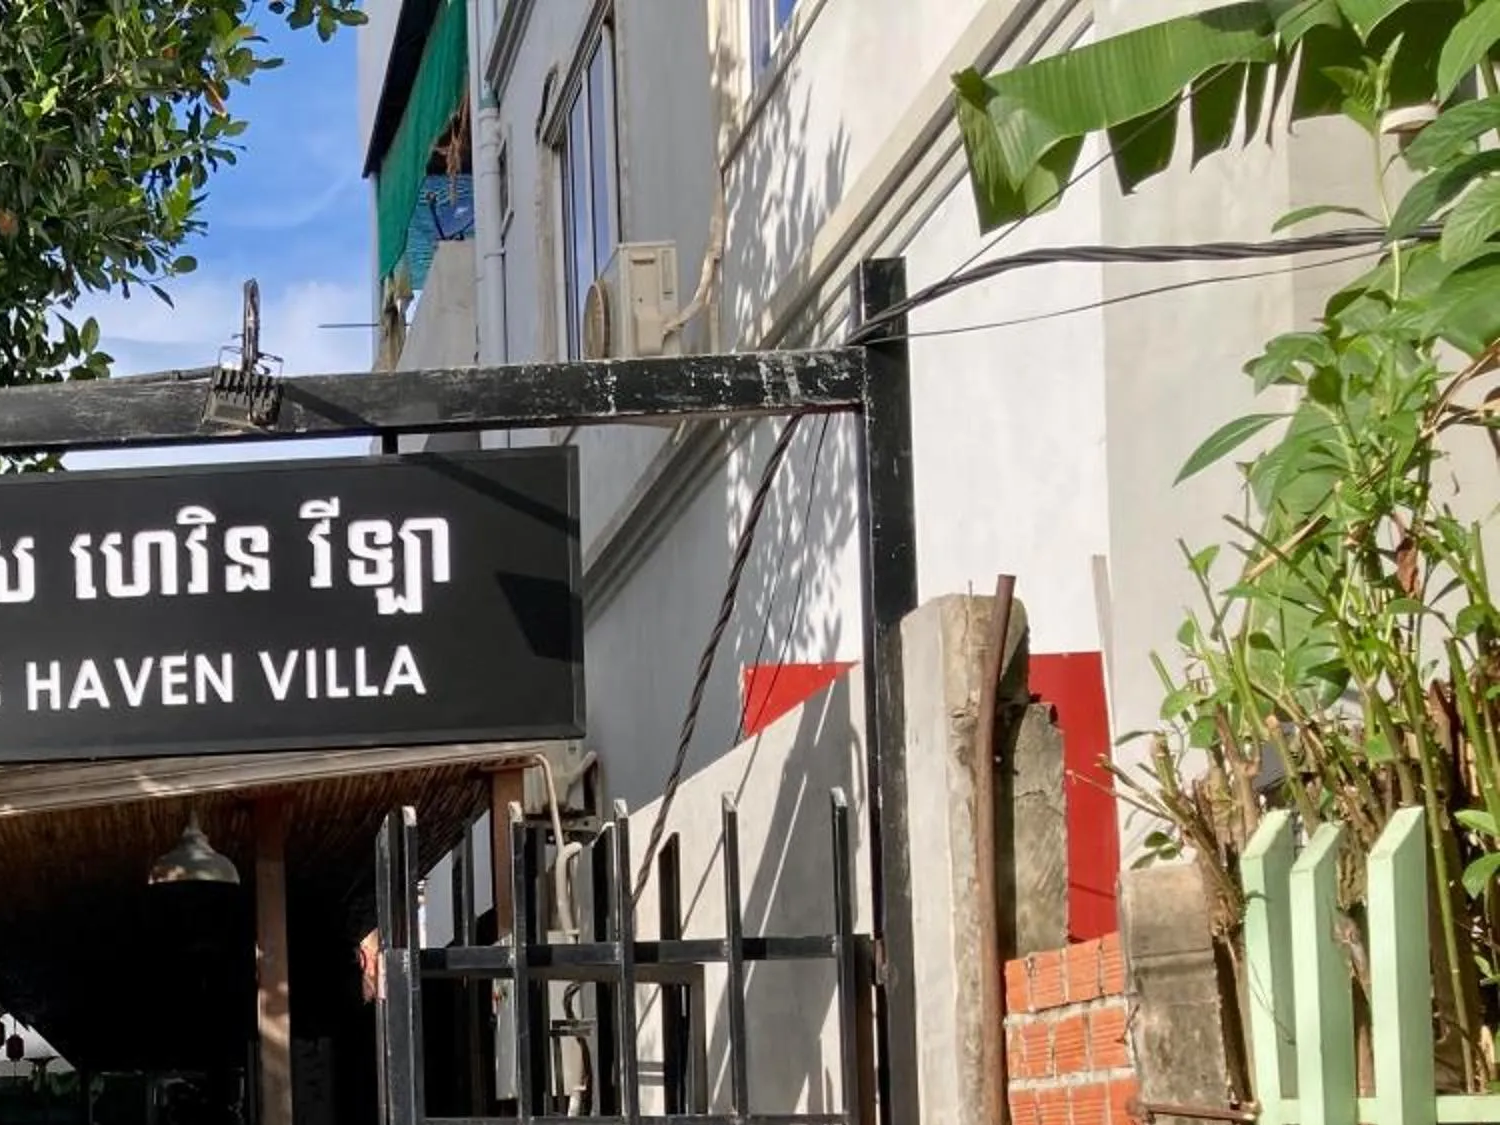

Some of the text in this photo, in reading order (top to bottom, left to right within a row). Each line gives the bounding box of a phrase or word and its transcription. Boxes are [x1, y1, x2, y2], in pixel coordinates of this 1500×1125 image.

[299, 496, 450, 615] វីឡា
[26, 652, 234, 712] HAVEN
[258, 645, 427, 701] VILLA
